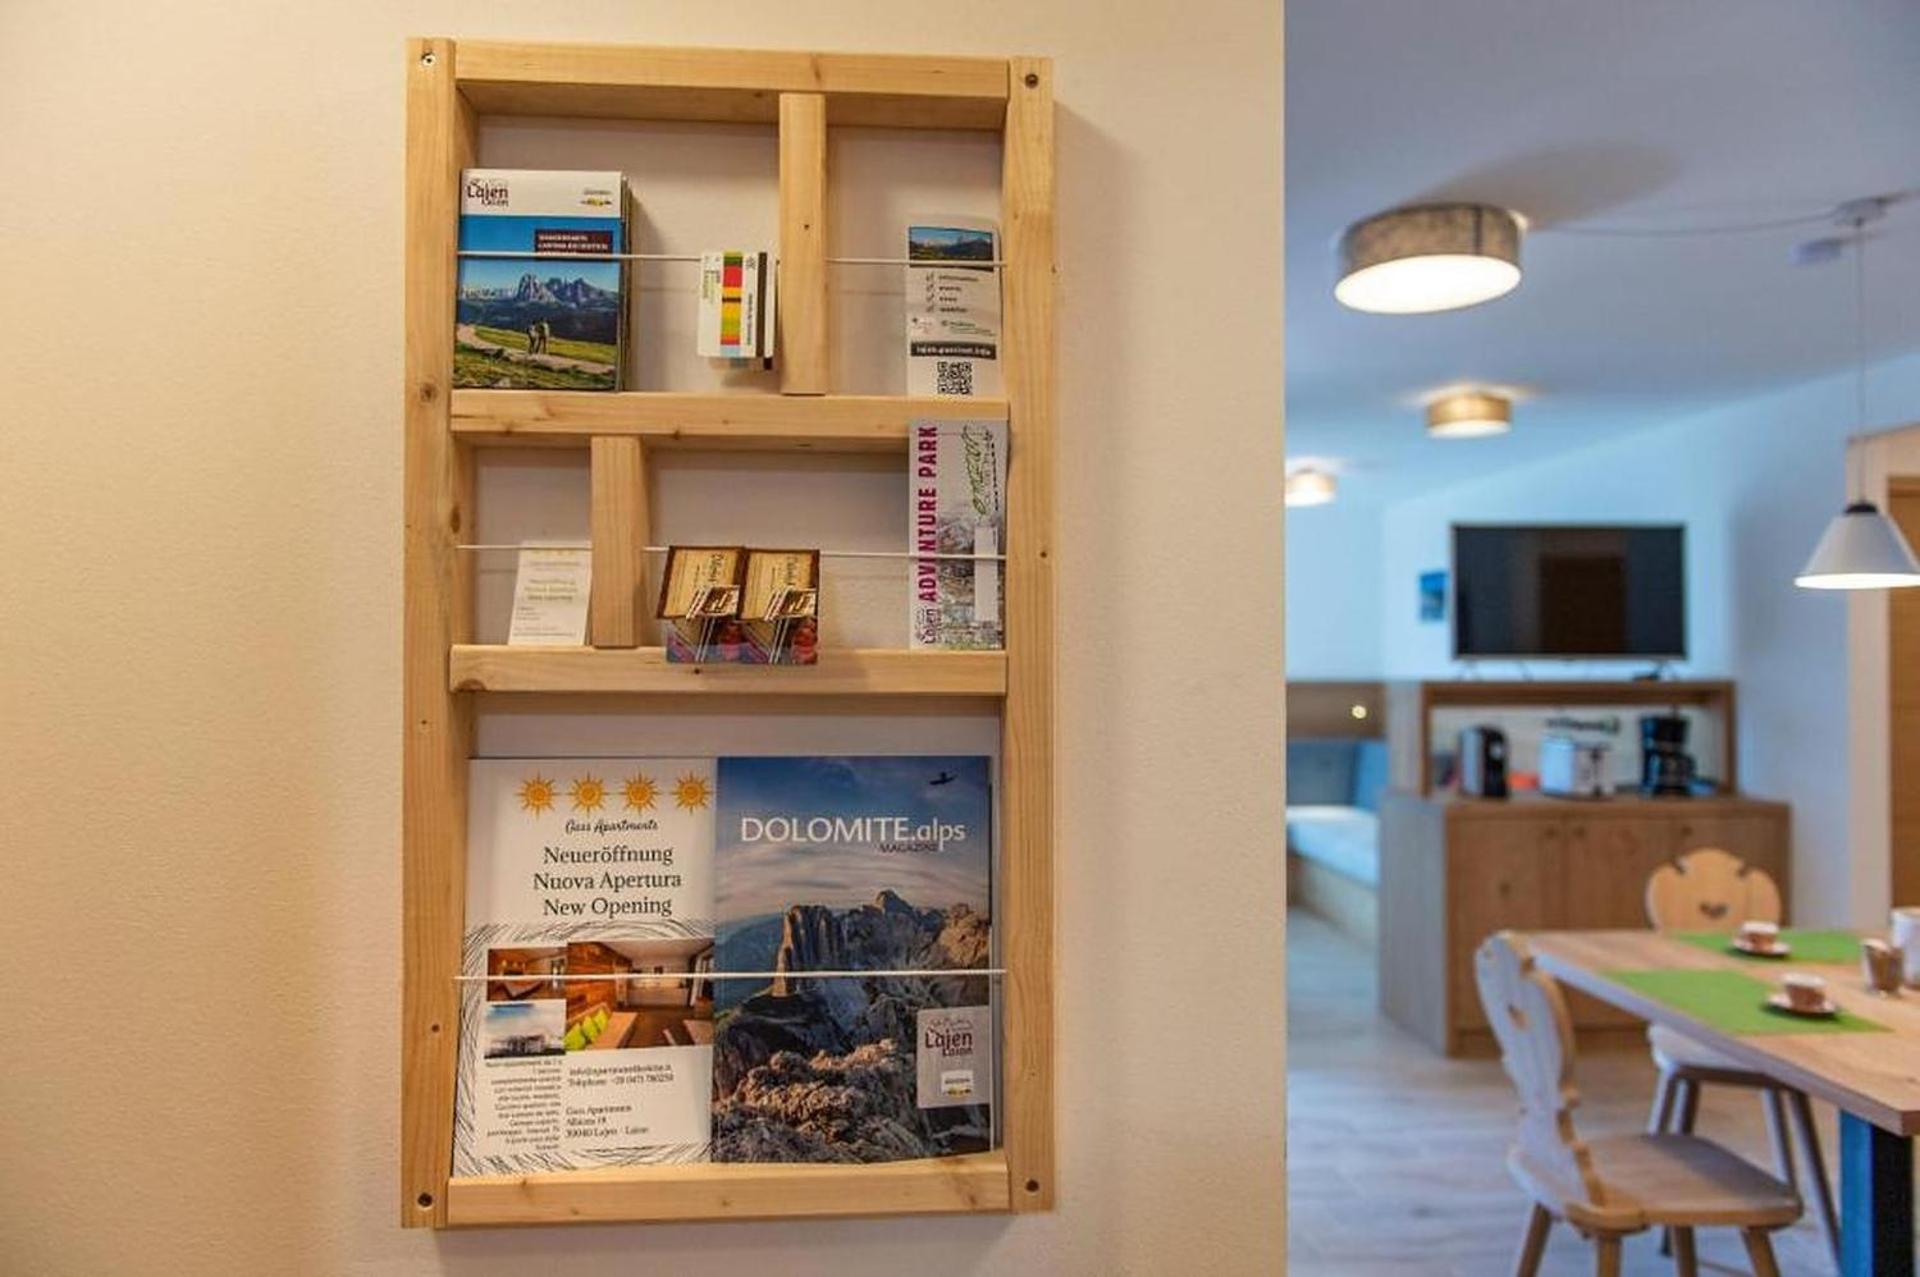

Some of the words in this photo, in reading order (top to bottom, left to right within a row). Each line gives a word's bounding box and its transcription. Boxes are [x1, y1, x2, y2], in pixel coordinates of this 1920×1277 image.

[918, 427, 937, 478] PARK
[918, 487, 937, 603] ADVNTURE
[594, 819, 659, 837] Apartments
[741, 817, 966, 852] DOLOMITE.alps
[543, 844, 674, 866] Neueröffnung
[534, 872, 595, 890] Nuova
[599, 871, 682, 893] Apertura
[543, 898, 586, 916] New
[591, 896, 673, 919] Opening
[925, 1026, 973, 1049] Lajen
